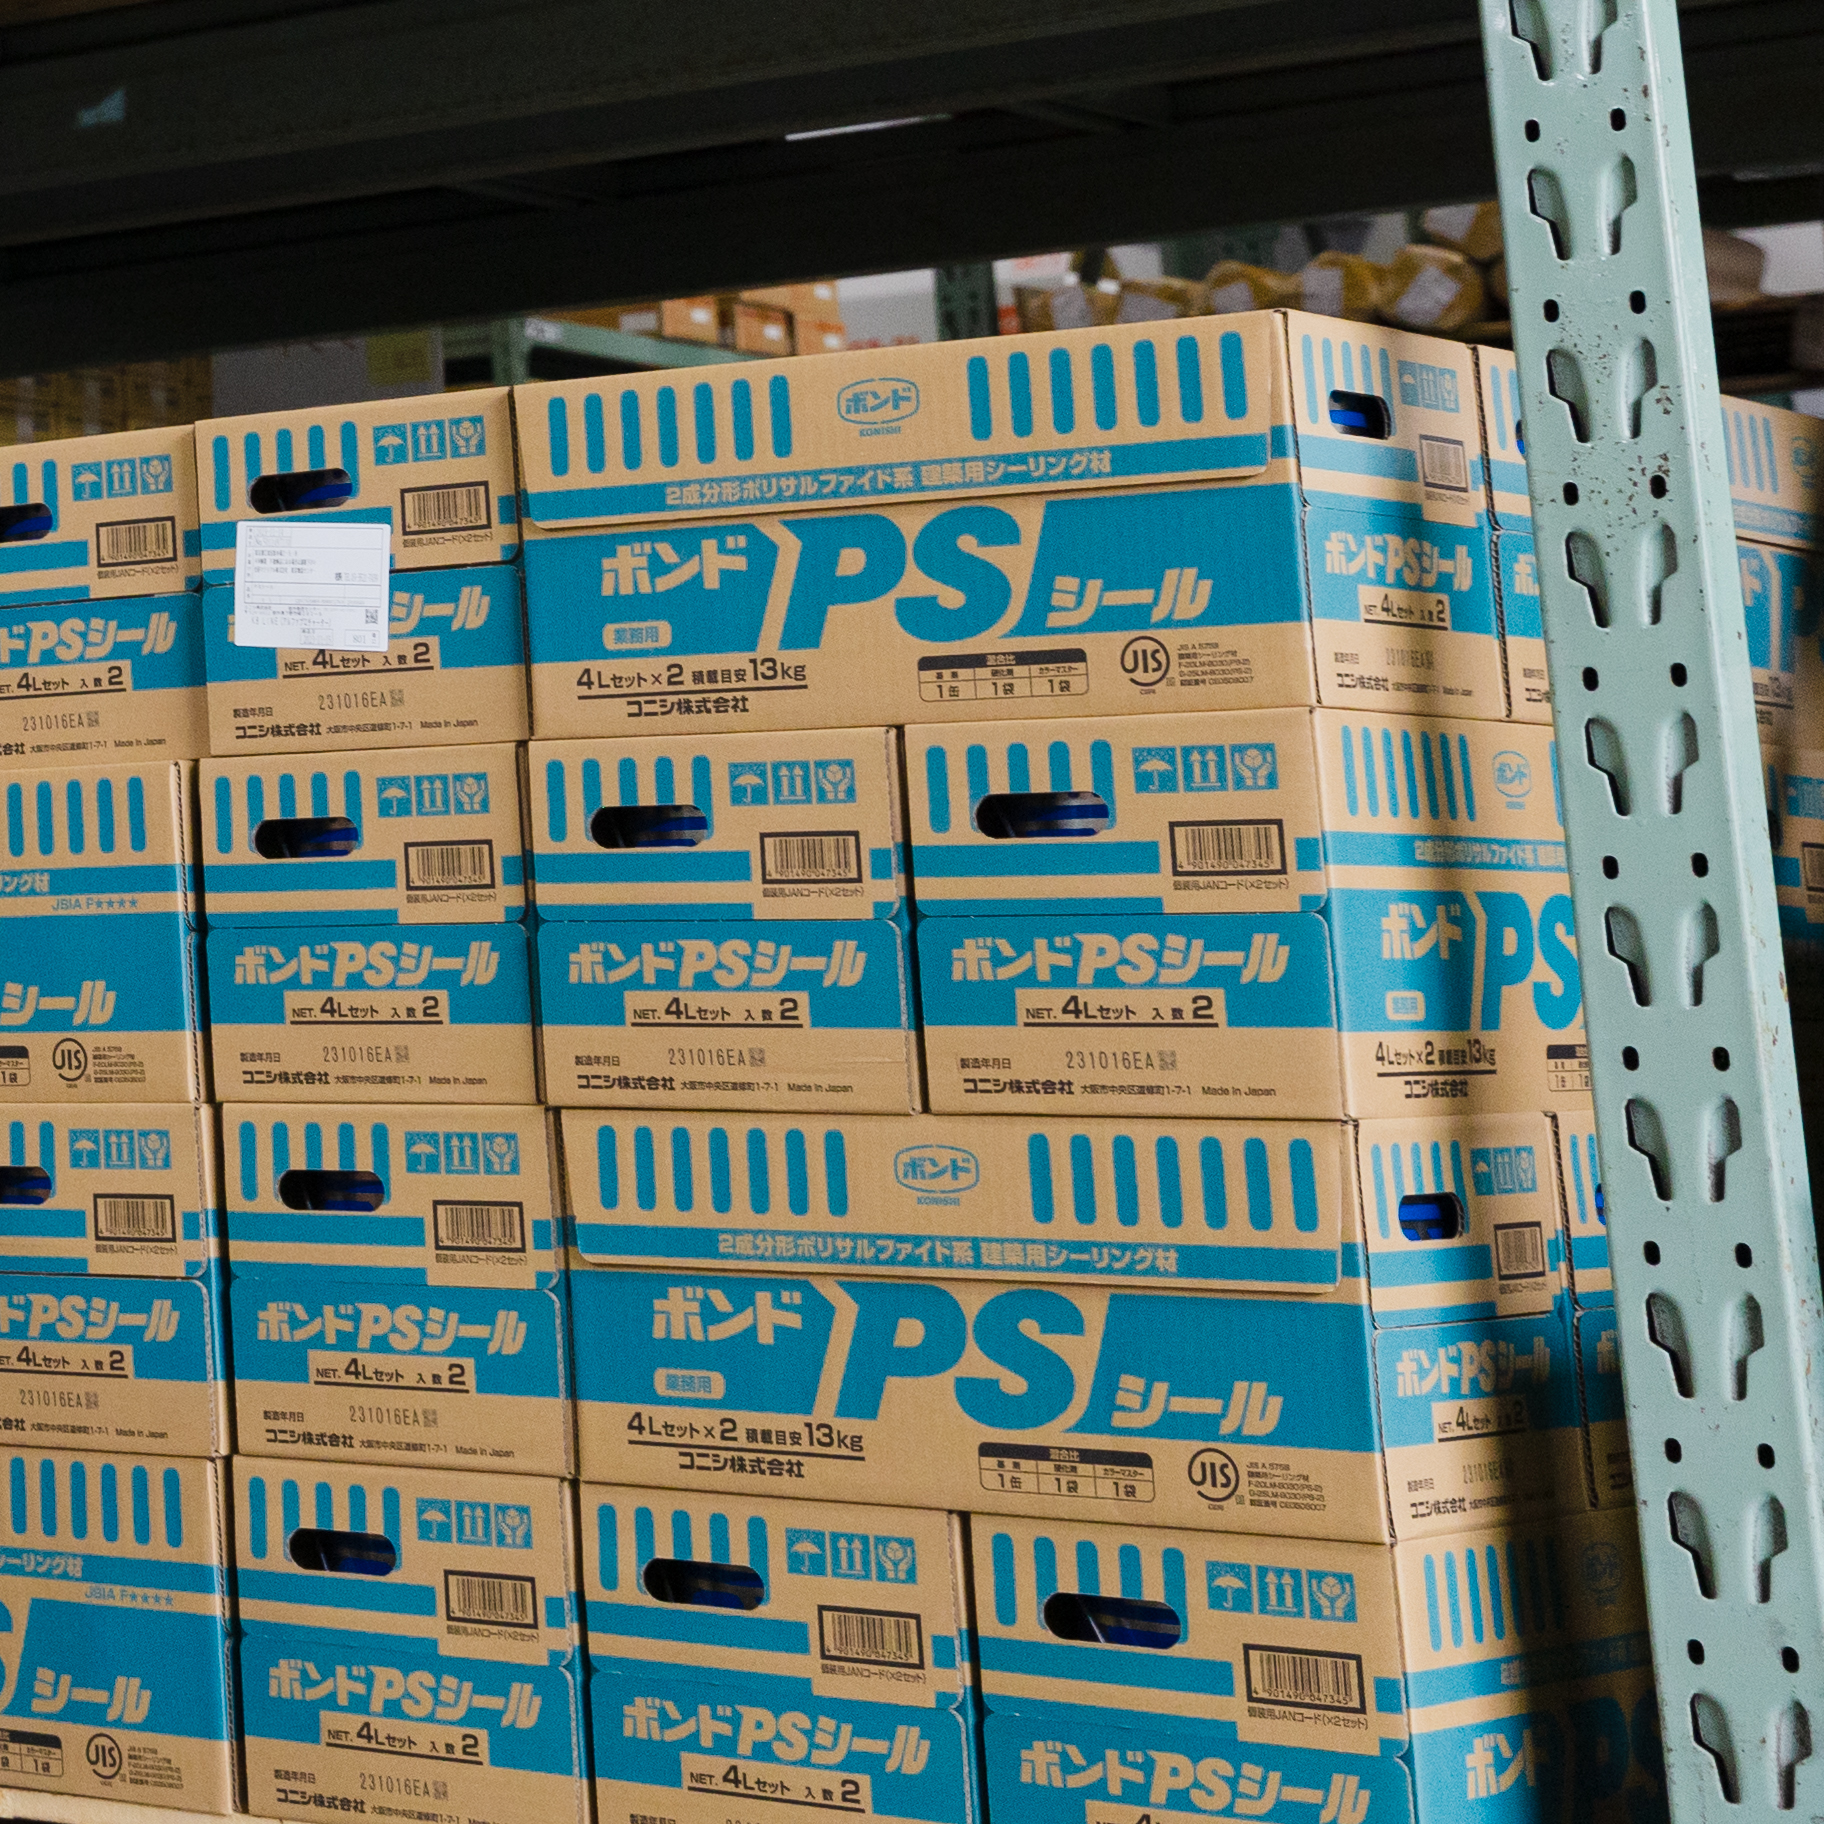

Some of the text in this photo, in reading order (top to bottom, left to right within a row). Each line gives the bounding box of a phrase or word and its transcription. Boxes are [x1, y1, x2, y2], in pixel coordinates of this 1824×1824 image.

[845, 385, 912, 416] ボンド
[601, 505, 1214, 651] ボンド PS シール
[626, 696, 750, 718] コニシ株式会社
[0, 980, 116, 1028] シール
[1026, 1008, 1057, 1020] NET.
[1192, 996, 1214, 1019] 2
[1066, 1051, 1154, 1069] 231016EA
[964, 1079, 1074, 1095] コニシ株式会社
[902, 1156, 971, 1183] ボンド
[652, 1280, 1284, 1436] ボンド PS シール
[678, 1452, 805, 1478] コニシ株式会社
[31, 1669, 152, 1724] シール
